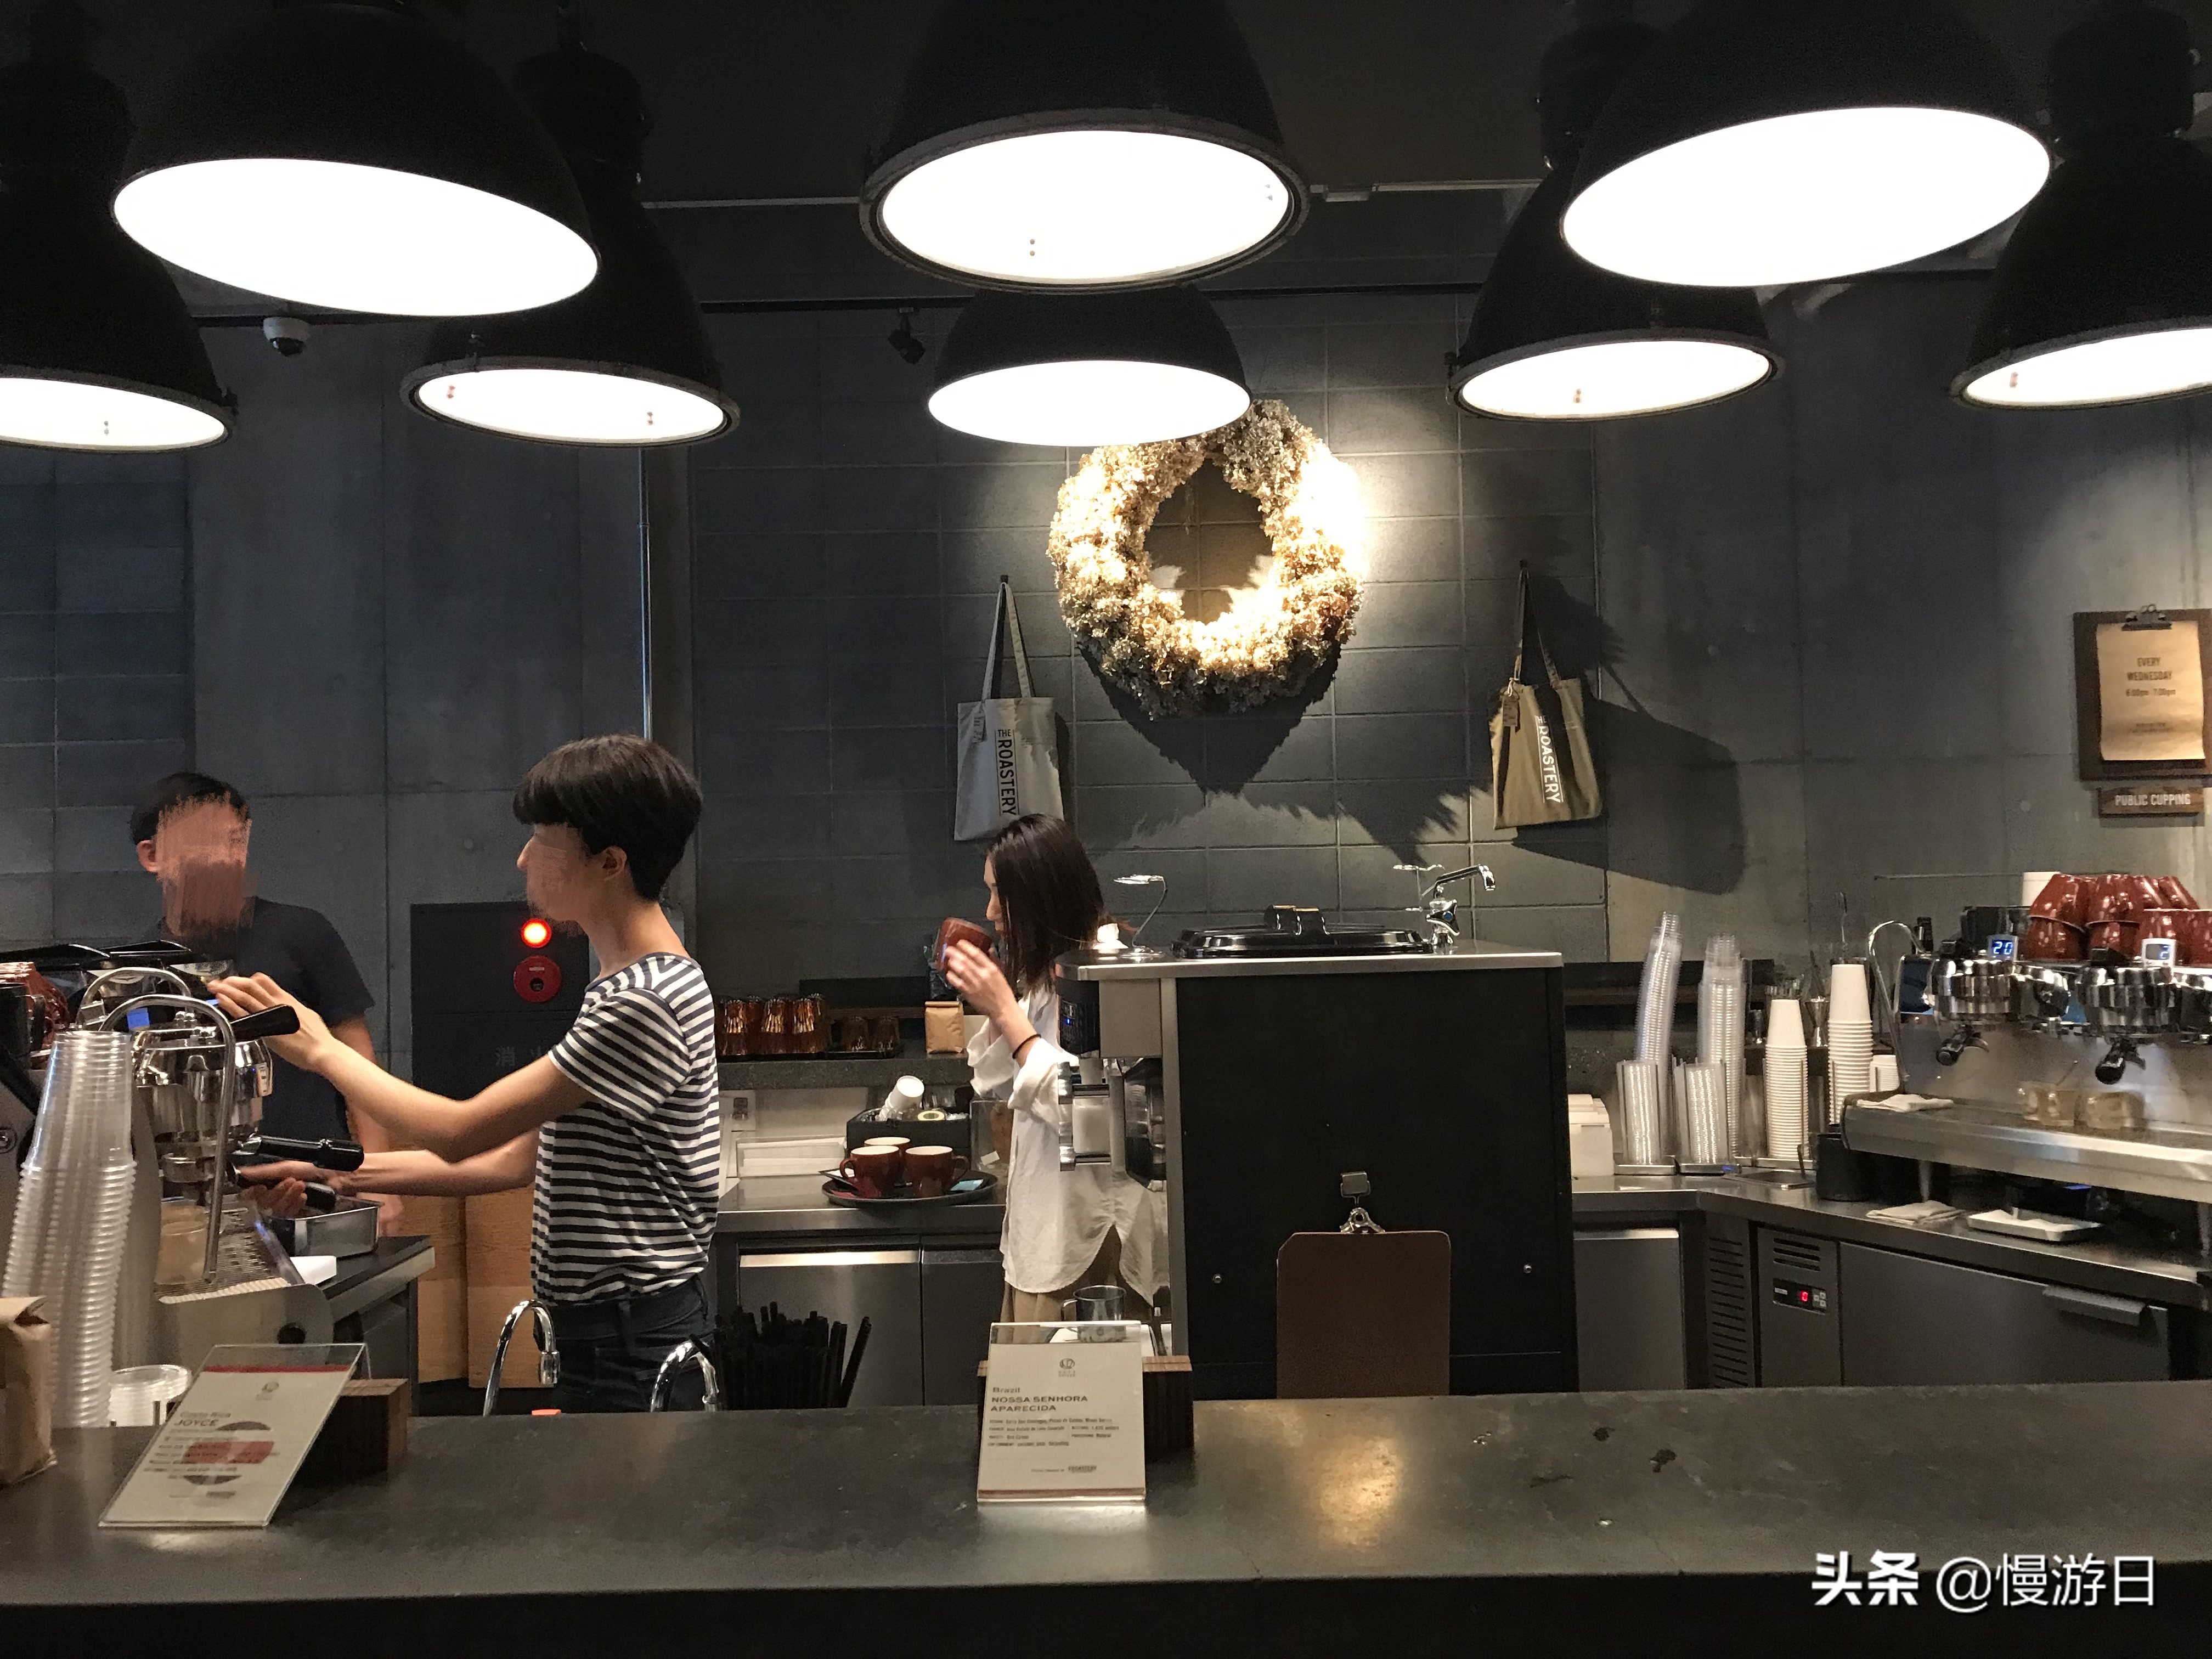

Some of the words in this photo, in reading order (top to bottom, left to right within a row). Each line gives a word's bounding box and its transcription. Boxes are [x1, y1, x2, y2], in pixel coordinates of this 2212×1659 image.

[2137, 657, 2161, 667] EVERY
[2127, 671, 2172, 681] WEDNESDAY
[998, 729, 1012, 737] THE
[1538, 725, 1561, 803] ROASTERY
[998, 739, 1017, 815] ROASTERY
[2115, 794, 2148, 806] PUBLIC
[2150, 793, 2191, 805] CUPPING
[1993, 941, 2013, 955] 20
